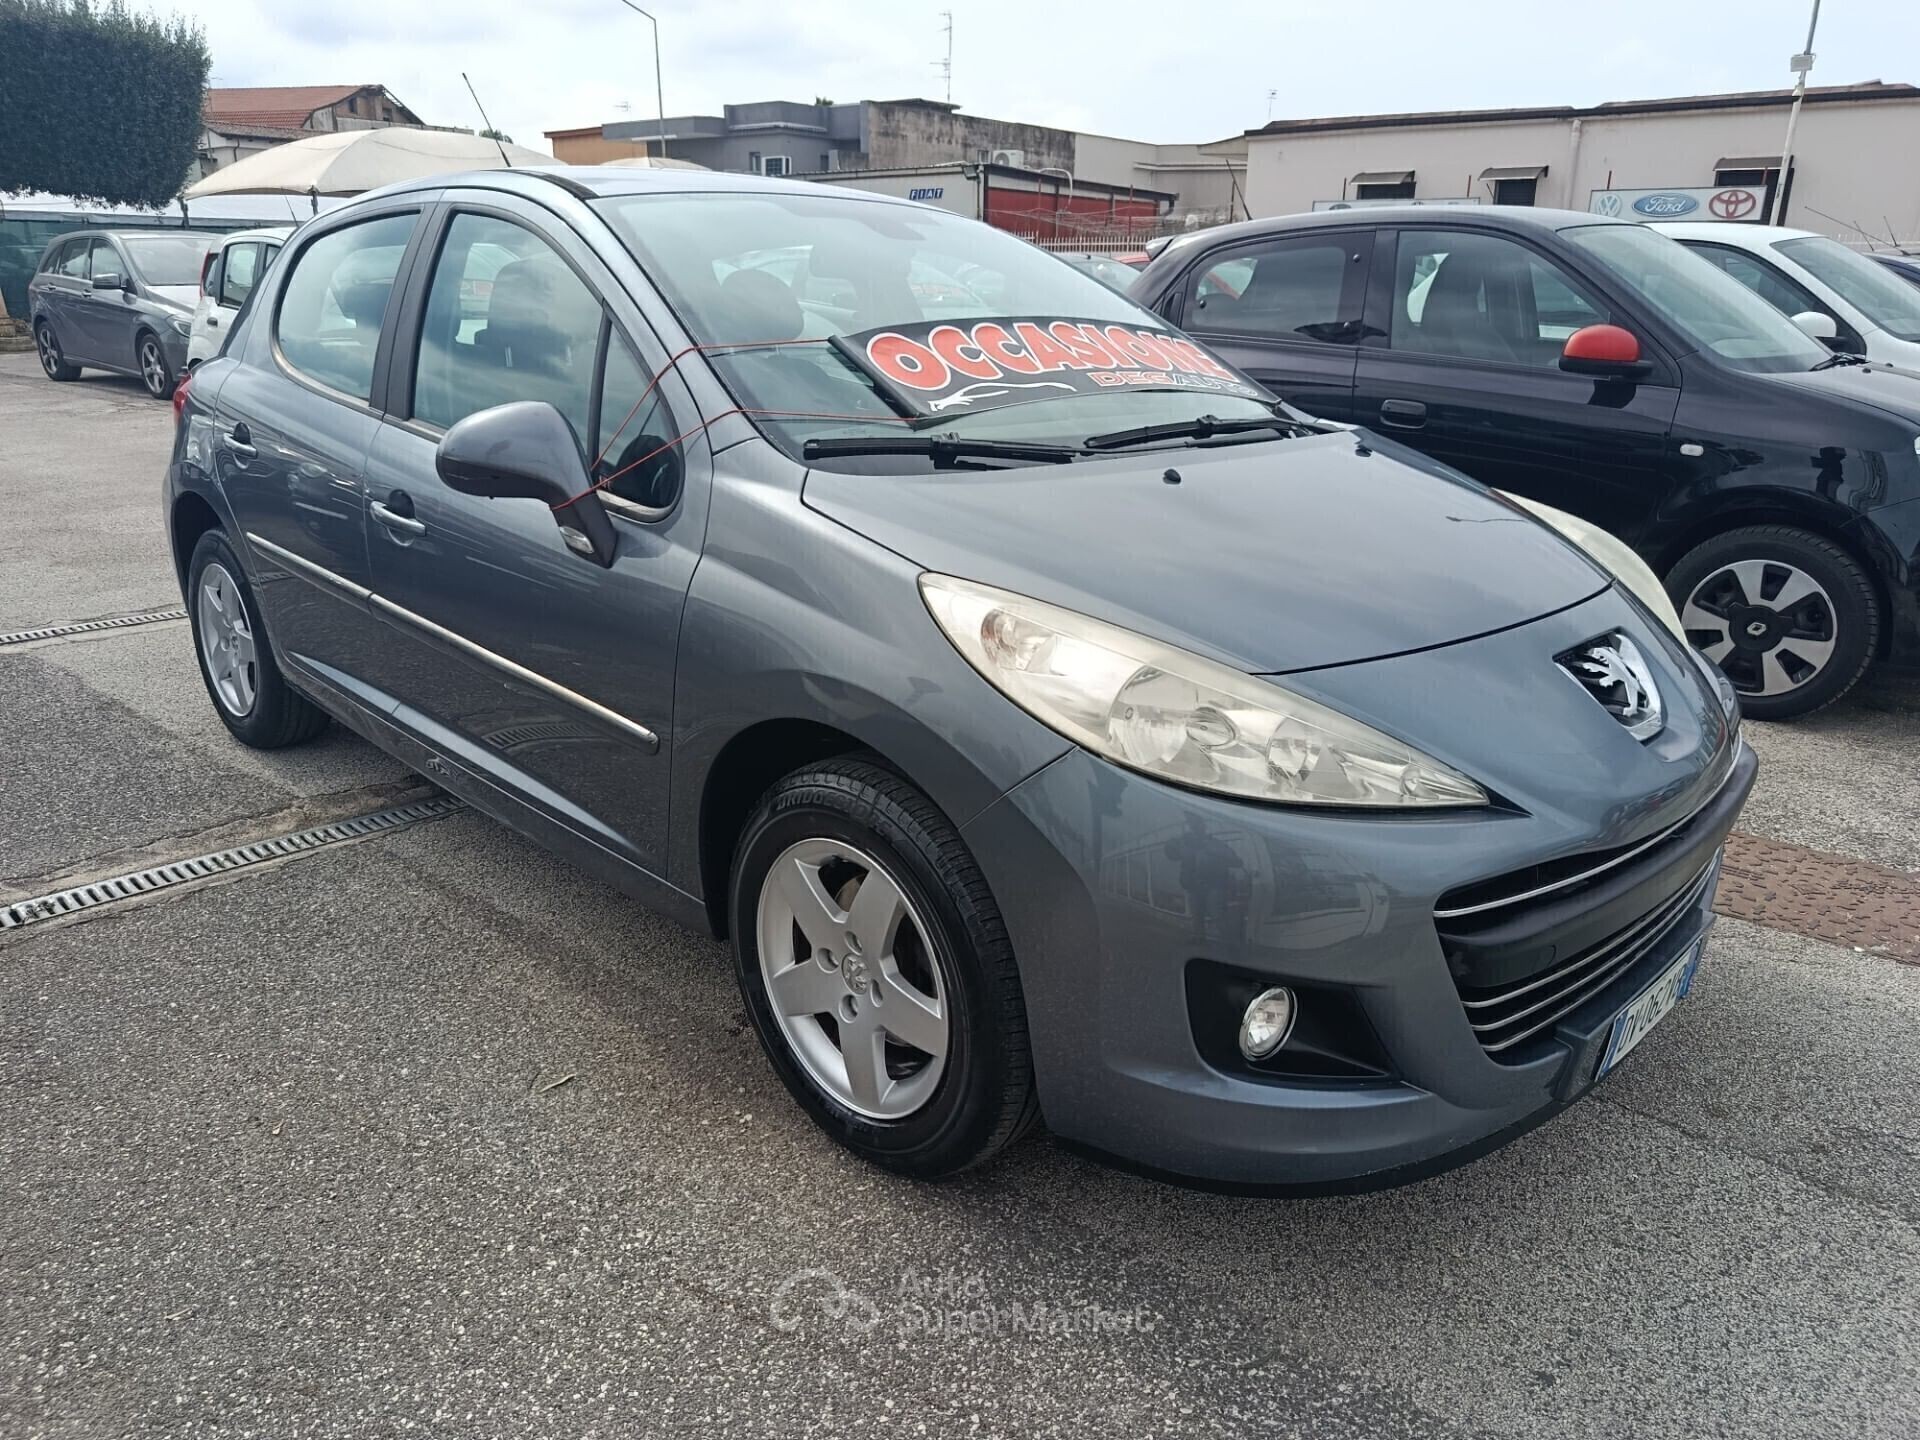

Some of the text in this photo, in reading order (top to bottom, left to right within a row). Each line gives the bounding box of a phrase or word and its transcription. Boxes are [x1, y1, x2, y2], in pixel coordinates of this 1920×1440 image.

[910, 188, 943, 200] FIAT
[1644, 195, 1687, 213] Ford
[866, 322, 1240, 391] OCCASIONE
